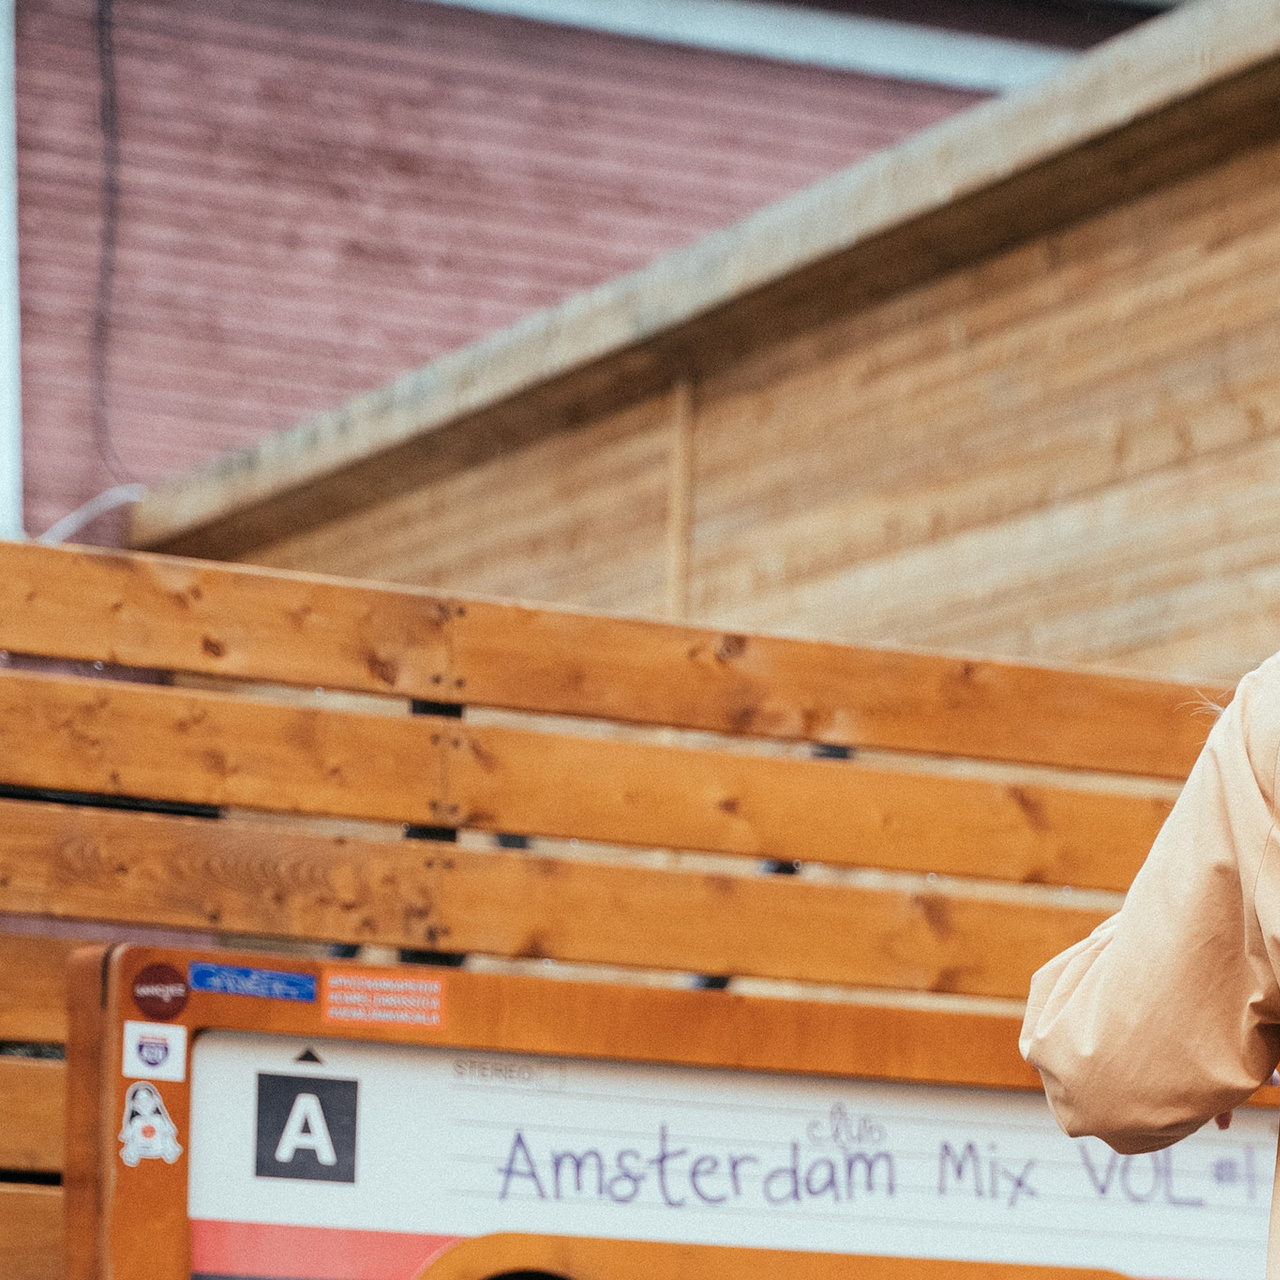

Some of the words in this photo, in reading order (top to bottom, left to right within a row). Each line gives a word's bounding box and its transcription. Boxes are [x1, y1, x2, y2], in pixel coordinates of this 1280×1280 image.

[453, 1059, 535, 1082] STEREO
[274, 1092, 338, 1166] A
[496, 1122, 896, 1210] Amsterdam
[938, 1140, 1039, 1208] Mix
